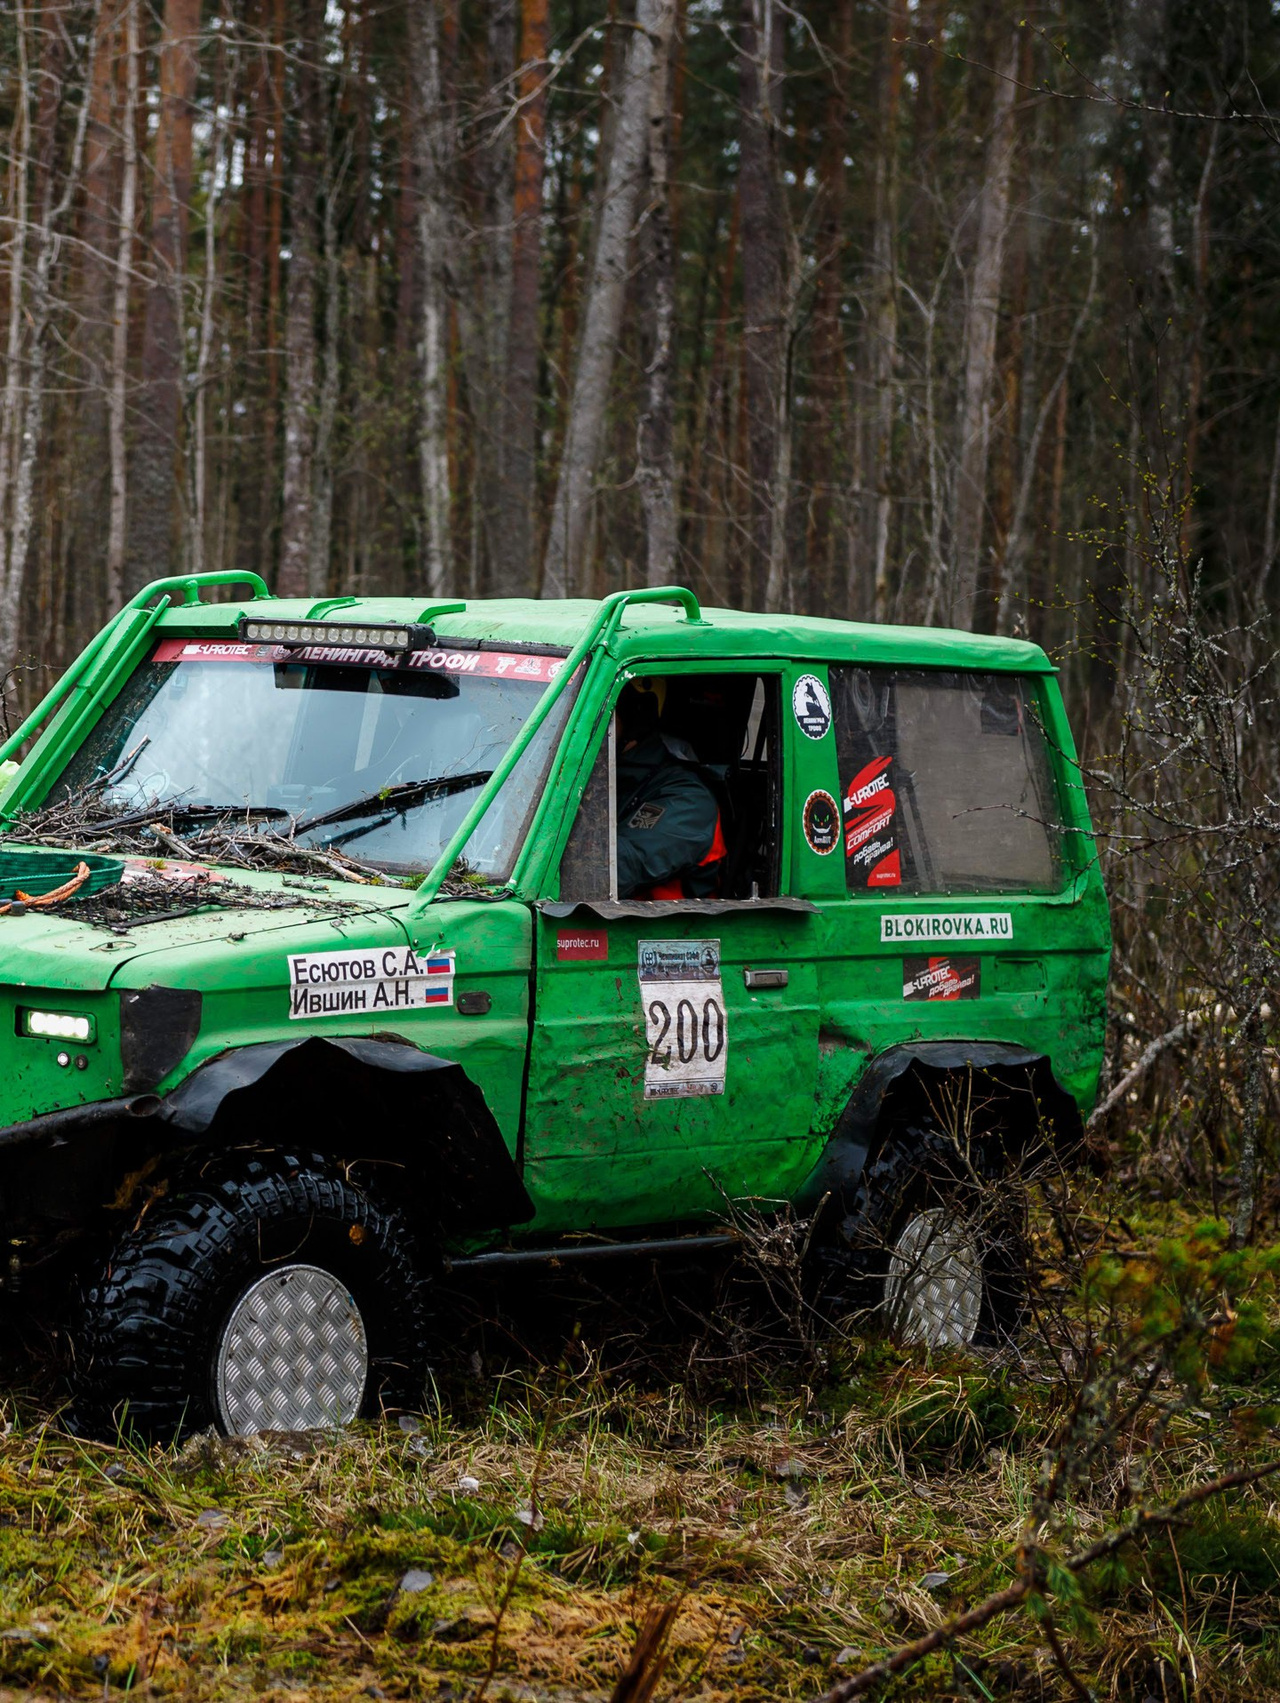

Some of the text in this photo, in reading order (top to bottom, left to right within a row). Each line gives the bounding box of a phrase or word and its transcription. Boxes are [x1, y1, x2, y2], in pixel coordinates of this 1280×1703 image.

[197, 644, 252, 655] SUPROTEC
[297, 646, 401, 668] ЛЕНИНГРАД
[407, 650, 480, 672] ТРОФИ
[847, 773, 890, 808] SUPROTEC
[847, 814, 892, 850] COMFORT
[885, 917, 1009, 937] BLOKIROVKA.RU
[557, 938, 599, 950] suprotec.ru
[293, 950, 424, 985] Есютов С.А.
[909, 966, 952, 990] SUPROTEC
[293, 980, 415, 1015] Ившин А.Н.
[649, 998, 724, 1065] 200
